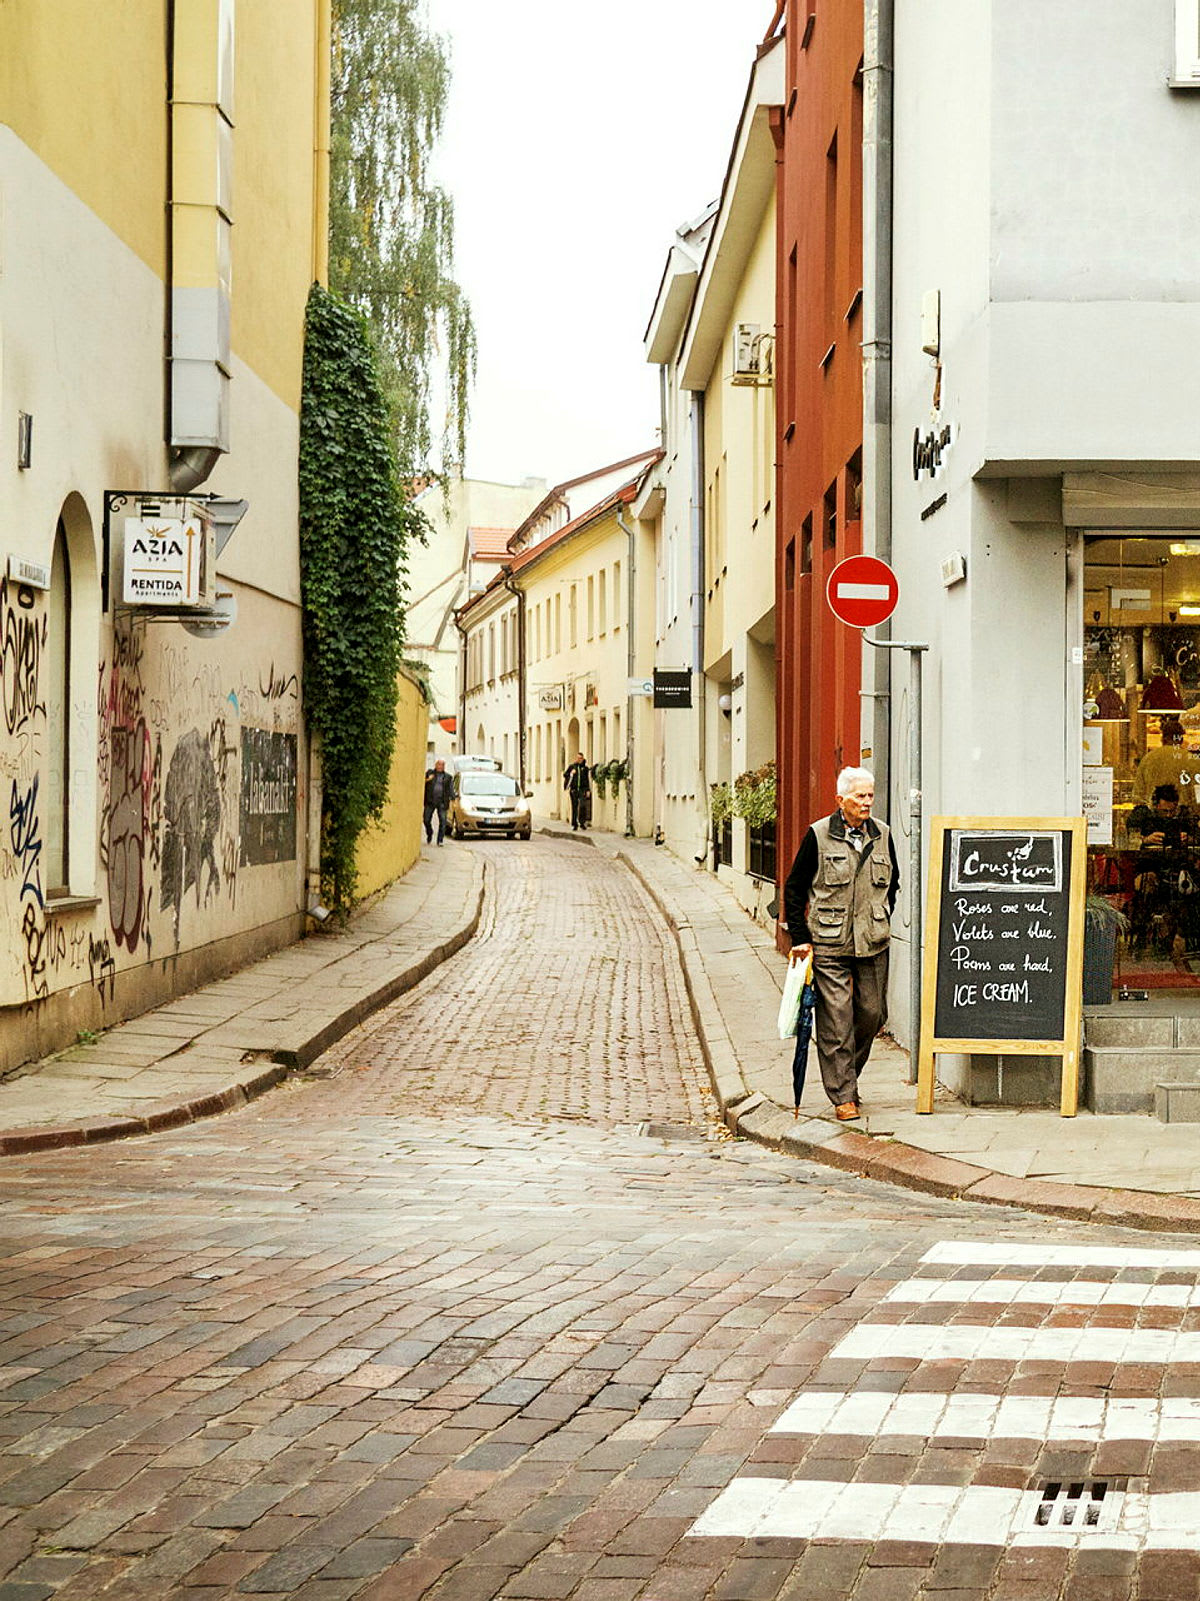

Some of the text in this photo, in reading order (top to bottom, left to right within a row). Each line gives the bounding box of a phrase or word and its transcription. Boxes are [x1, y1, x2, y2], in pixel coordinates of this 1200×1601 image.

[132, 539, 183, 556] AZIA
[131, 578, 182, 591] RENTIDA
[963, 850, 1053, 883] Crustum
[954, 897, 1053, 917] Roses are red,
[1001, 930, 1020, 939] are
[950, 945, 992, 971] Poems
[998, 962, 1016, 971] are
[953, 980, 1033, 1007] ICE CREAM.
